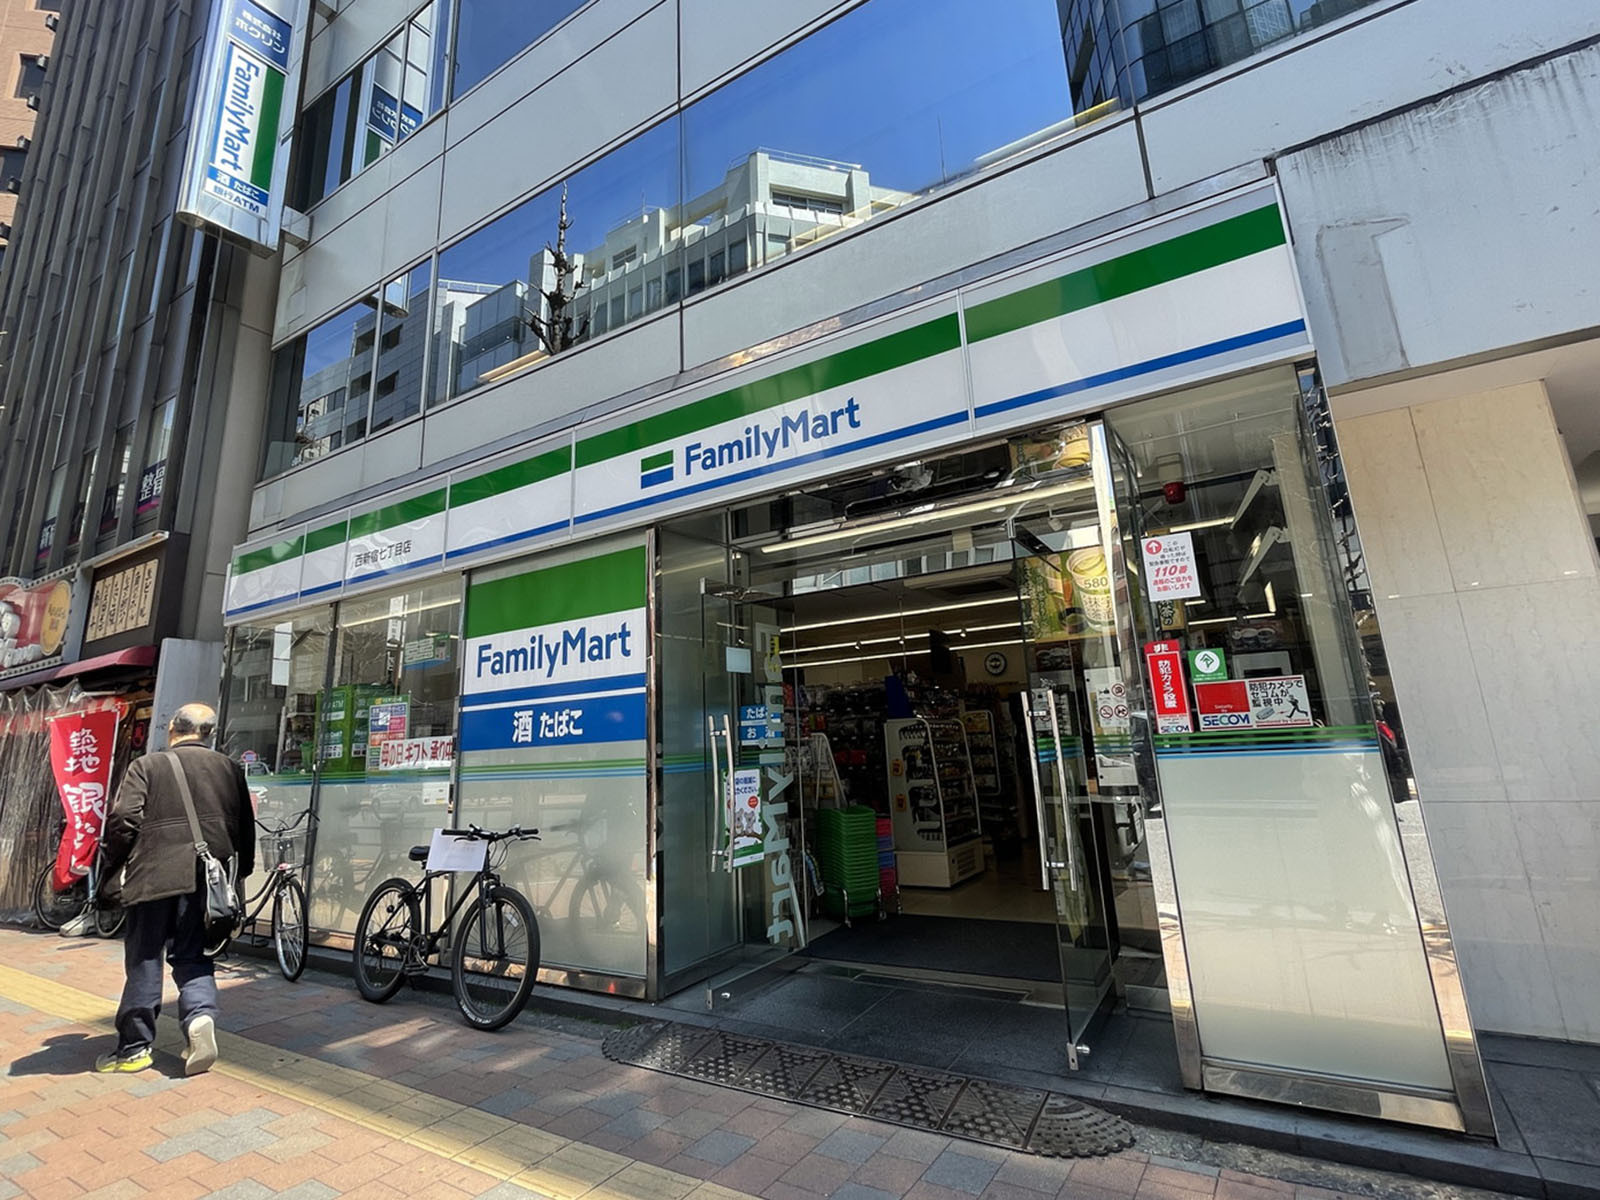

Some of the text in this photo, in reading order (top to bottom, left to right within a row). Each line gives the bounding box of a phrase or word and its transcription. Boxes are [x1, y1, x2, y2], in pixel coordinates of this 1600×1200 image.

[220, 55, 260, 171] FamilyMart
[216, 170, 260, 200] 酒 たばこ
[685, 397, 861, 476] FamilyMart
[355, 540, 412, 568] 西新宿七丁目店
[1155, 565, 1187, 577] 110番
[1084, 577, 1108, 589] 580
[477, 622, 631, 678] FamilyMart
[1249, 680, 1303, 691] 防犯カメラで
[1251, 689, 1289, 698] セコムが
[1252, 698, 1284, 707] 監視中
[512, 709, 583, 743] 酒 たばこ
[1203, 713, 1250, 726] SECOM
[1161, 725, 1190, 734] SECOM
